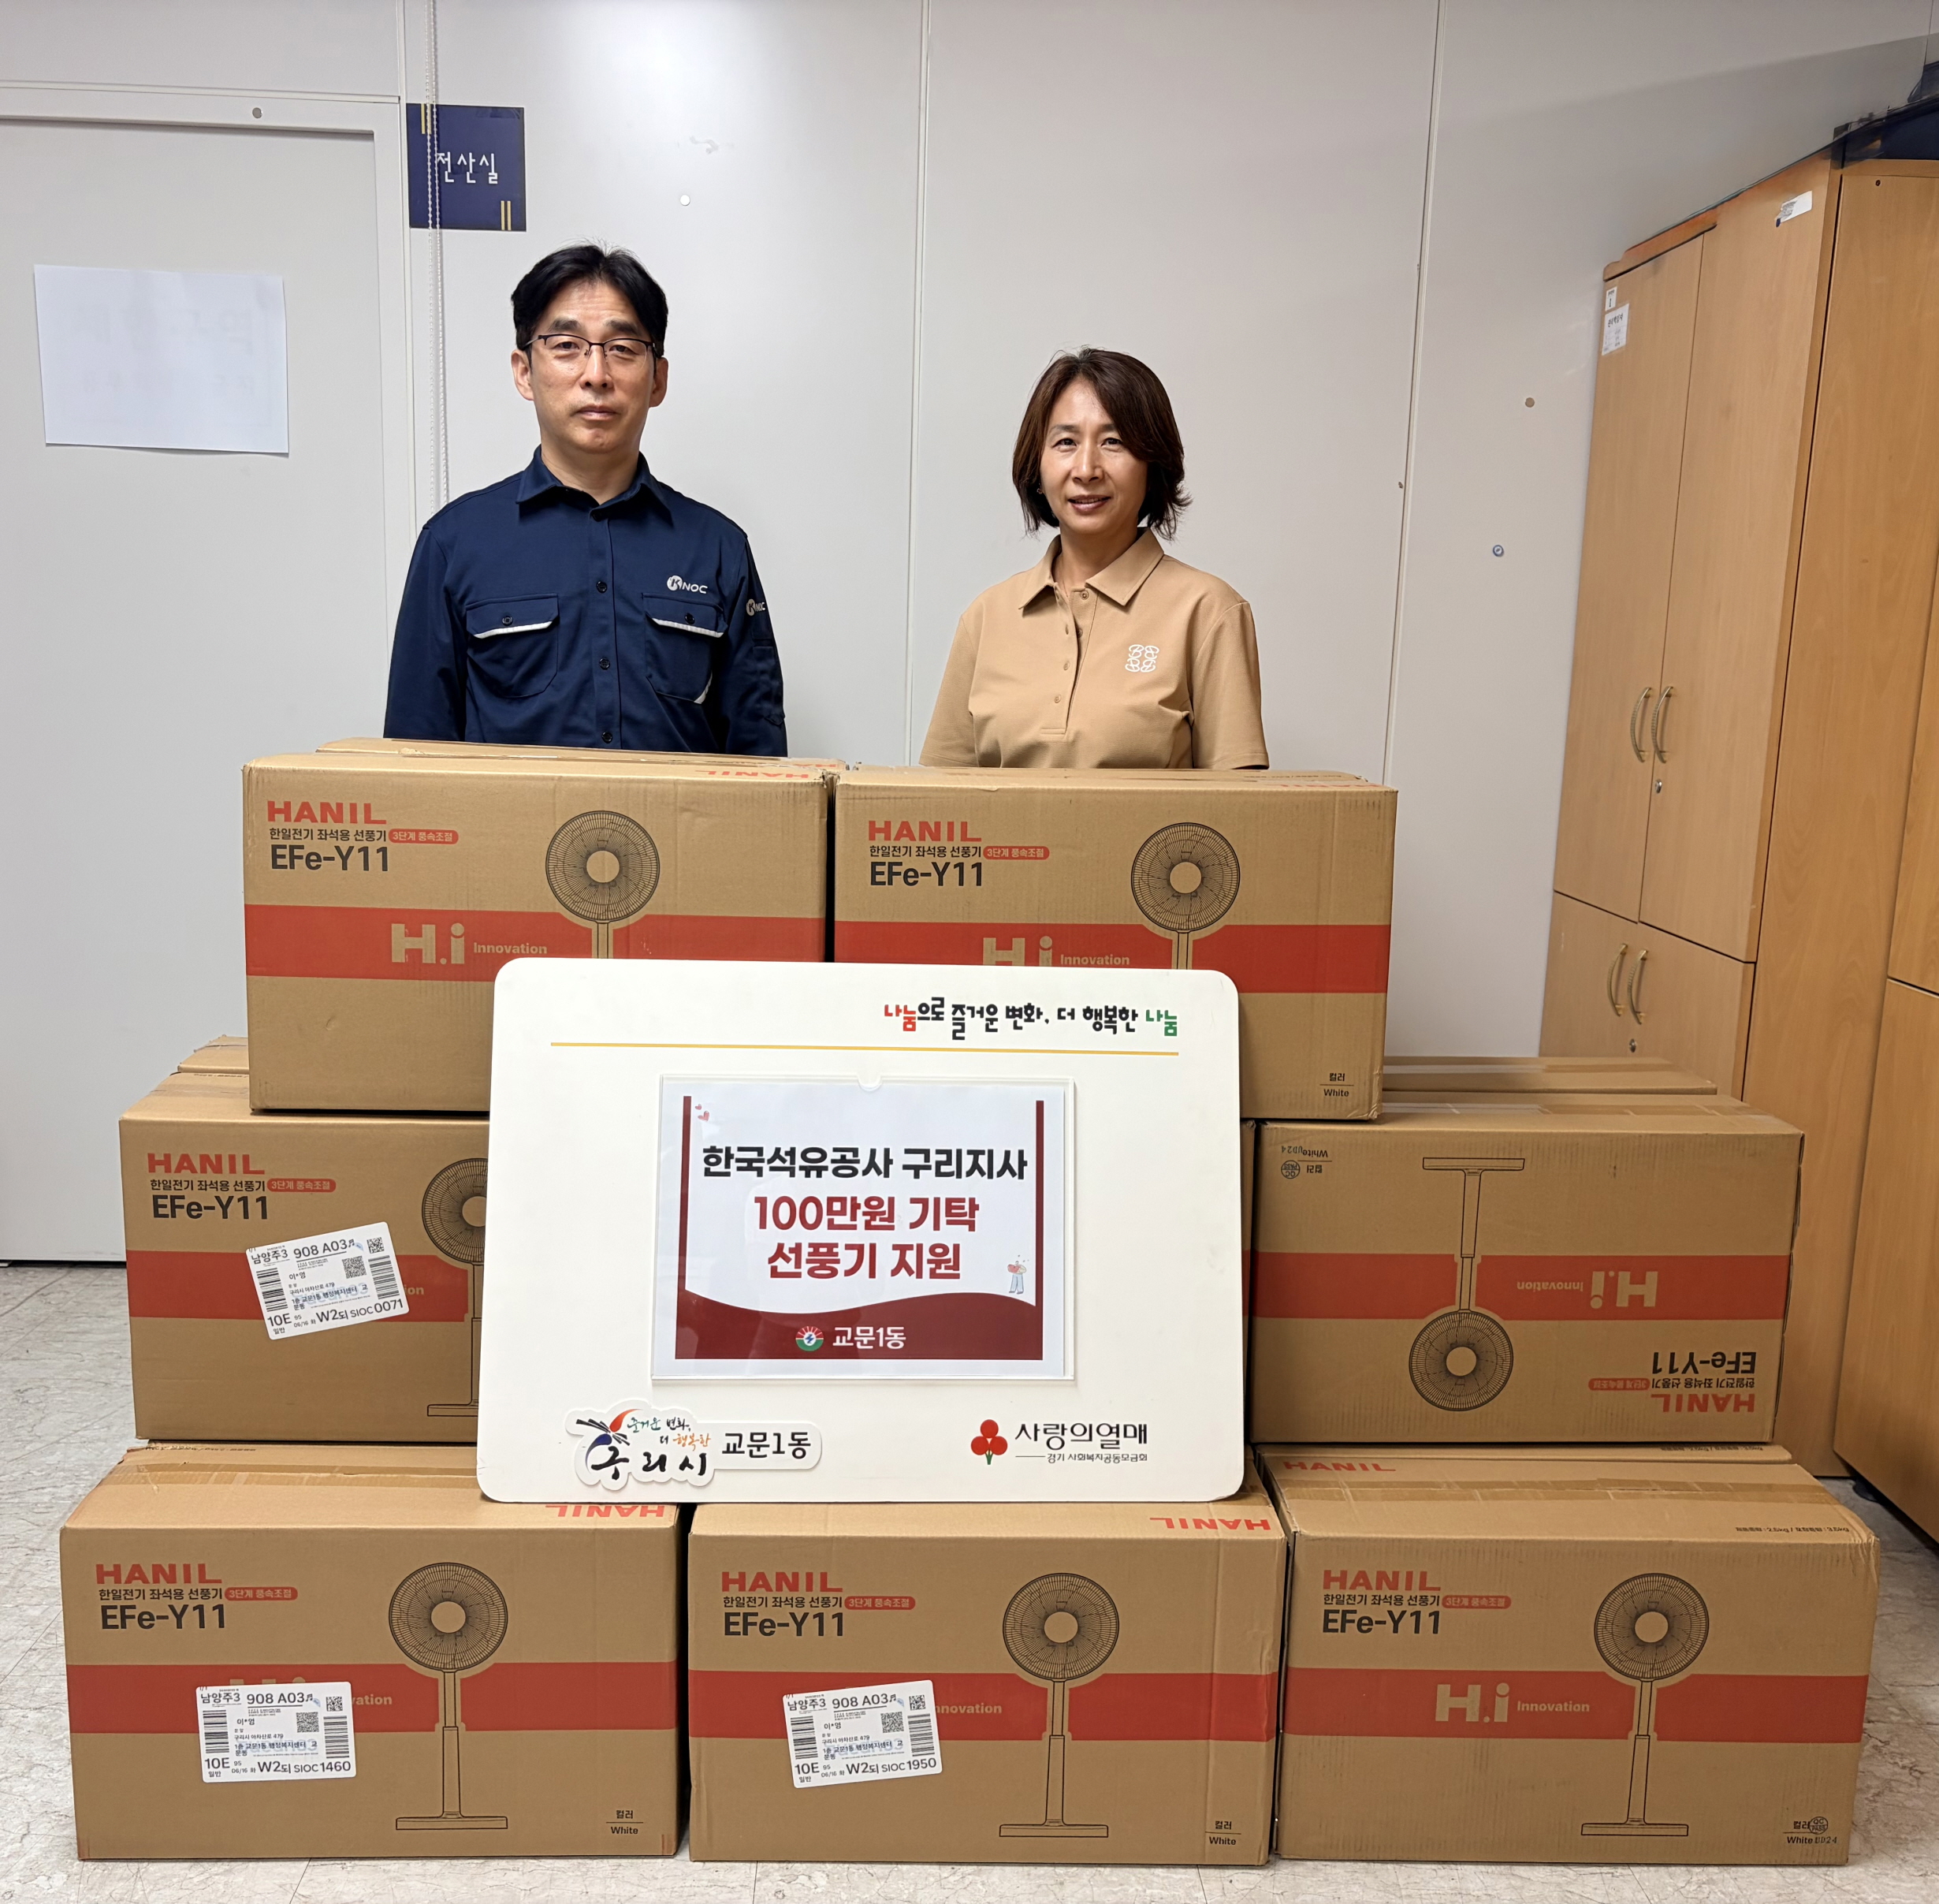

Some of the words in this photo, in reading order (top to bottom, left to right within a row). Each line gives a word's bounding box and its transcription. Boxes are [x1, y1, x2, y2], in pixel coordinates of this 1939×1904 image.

[436, 151, 498, 184] 전산실
[667, 575, 708, 594] KNOC
[746, 598, 766, 617] KNOC
[267, 800, 387, 825] HANIL
[270, 828, 314, 841] 한일전기
[317, 828, 351, 842] 좌석용
[354, 829, 386, 843] 선풍기
[393, 831, 415, 842] 3단계
[418, 831, 453, 843] 풍속조절
[869, 820, 982, 842] HANIL
[271, 844, 389, 872] EFe-Y11
[869, 845, 912, 858] 한일전기
[915, 845, 947, 859] 좌석용
[950, 845, 982, 859] 선풍기
[987, 848, 1009, 859] 3단계
[1011, 848, 1045, 859] 풍속조절
[870, 862, 983, 887] EFe-Y11
[391, 922, 465, 965] H.i
[474, 941, 547, 955] Innovation
[1060, 953, 1130, 966] Innovation
[884, 997, 945, 1032] 나눔으로
[951, 1004, 999, 1041] 즐거운
[1005, 1003, 1050, 1030] 변화,
[1057, 1005, 1075, 1021] 더
[1082, 1004, 1138, 1034] 행복한
[1146, 1008, 1178, 1037] 나눔
[1329, 1073, 1345, 1082] 컬러
[1323, 1088, 1349, 1097] White
[147, 1153, 265, 1175] HANIL
[702, 1146, 893, 1179] 한국석유공사
[903, 1148, 1028, 1180] 구리지사
[150, 1179, 194, 1191] 한일전기
[198, 1179, 230, 1191] 좌석용
[234, 1179, 266, 1192] 선풍기
[271, 1180, 293, 1190] 3단계
[153, 1195, 268, 1220] EFe-Y11
[754, 1196, 895, 1231] 100만원
[908, 1197, 980, 1231] 기탁
[251, 1249, 288, 1265] 남양주3
[293, 1244, 319, 1259] 908
[322, 1239, 347, 1254] A03
[768, 1243, 876, 1280] 선풍기
[891, 1243, 960, 1280] 지원
[1517, 1280, 1584, 1291] Innovation
[1591, 1271, 1658, 1309] H.i
[267, 1313, 292, 1327] 10E
[832, 1326, 906, 1350] 교문1동
[1652, 1351, 1756, 1374] EFe-Y11
[1652, 1377, 1680, 1388] 선풍기
[1684, 1377, 1714, 1388] 좌석용
[1717, 1377, 1755, 1388] 한일전기
[1651, 1394, 1755, 1412] HANIL
[627, 1417, 661, 1433] 즐거운
[667, 1417, 691, 1432] 변화,
[661, 1436, 669, 1445] 더
[673, 1435, 711, 1451] 행복한
[1015, 1423, 1148, 1451] 사랑의열매
[722, 1432, 811, 1459] 교문1동
[591, 1446, 707, 1481] 구리시
[1047, 1453, 1065, 1464] 경기
[1067, 1453, 1148, 1464] 사회복지공동모금회
[1283, 1461, 1396, 1472] HANIL
[545, 1505, 664, 1518] HANIL
[1150, 1517, 1271, 1530] HANIL
[96, 1563, 222, 1585] HANIL
[1323, 1570, 1441, 1592] HANIL
[721, 1571, 843, 1593] HANIL
[99, 1588, 146, 1600] 한일전기
[149, 1589, 184, 1600] 좌석용
[188, 1588, 223, 1600] 선풍기
[229, 1589, 253, 1599] 3단계
[255, 1589, 292, 1599] 풍속조절
[1323, 1593, 1368, 1606] 한일전기
[1371, 1594, 1404, 1607] 좌석용
[1407, 1595, 1440, 1607] 선풍기
[723, 1596, 769, 1608] 한일전기
[772, 1597, 805, 1608] 좌석용
[809, 1596, 843, 1608] 선풍기
[848, 1598, 873, 1608] 3단계
[874, 1597, 910, 1608] 풍속조절
[1446, 1597, 1469, 1607] 3단계
[101, 1604, 225, 1630] EFe-Y11
[724, 1612, 844, 1637] EFe-Y11
[1322, 1609, 1440, 1634] EFe-Y11
[200, 1693, 240, 1704] 남양주3
[247, 1693, 274, 1705] 908
[277, 1692, 304, 1704] A03
[352, 1693, 393, 1706] ation
[787, 1698, 826, 1711] 남양주3
[832, 1697, 858, 1709] 908
[862, 1693, 888, 1706] A03
[1435, 1682, 1509, 1723] H.i
[1517, 1700, 1590, 1712] Innovation
[935, 1702, 1002, 1715] nnovation
[204, 1757, 230, 1769] 10E
[795, 1762, 820, 1775] 10E
[616, 1810, 633, 1819] 컬러
[611, 1826, 638, 1835] White
[1215, 1820, 1232, 1830] 컬러
[1209, 1836, 1237, 1845] White
